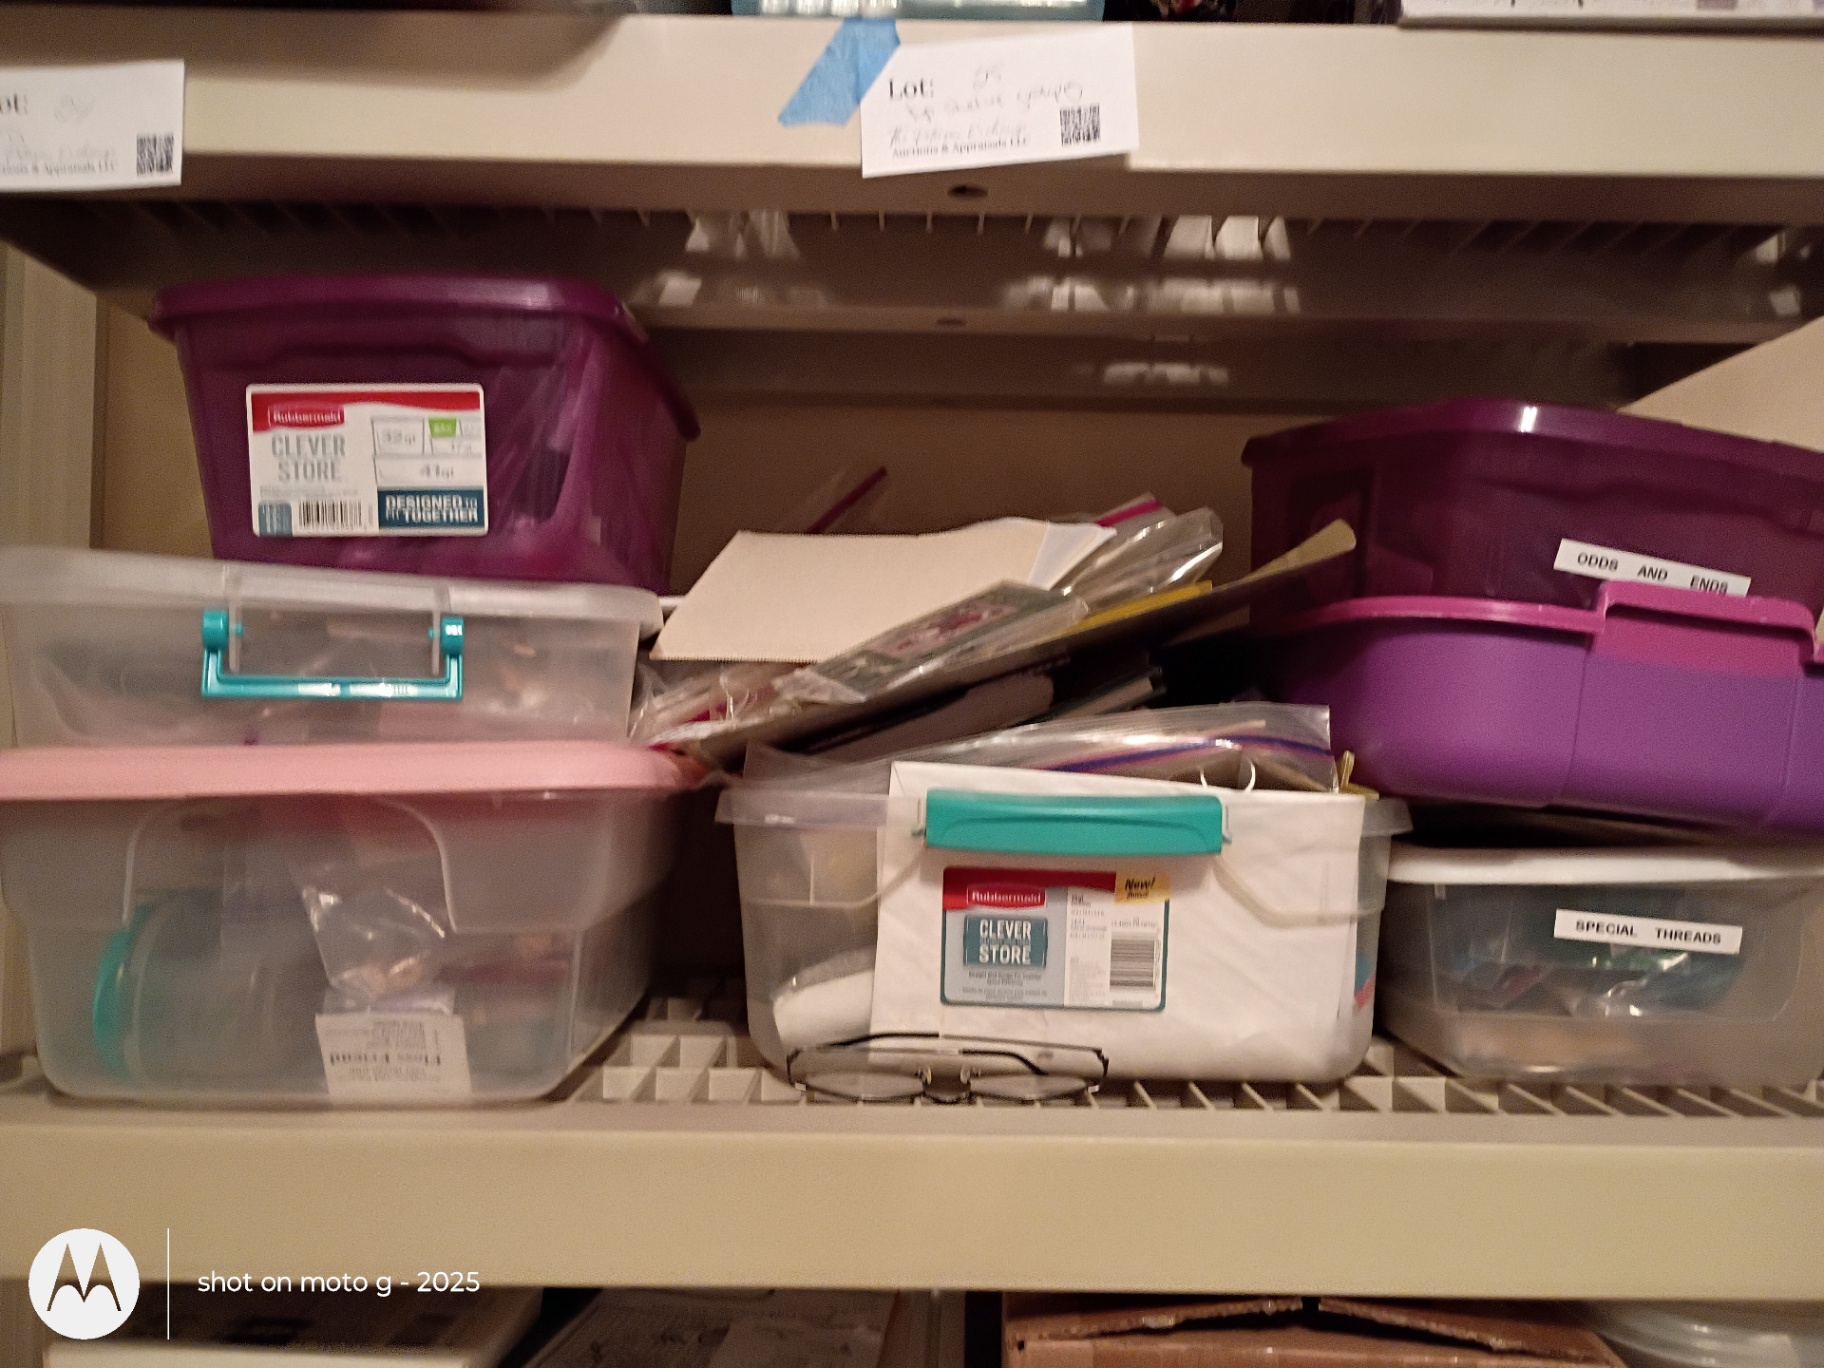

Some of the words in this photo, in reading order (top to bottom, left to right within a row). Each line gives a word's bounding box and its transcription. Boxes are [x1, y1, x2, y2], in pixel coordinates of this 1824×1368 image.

[889, 77, 933, 101] Lot:
[0, 92, 29, 116] ot:
[952, 138, 1007, 155] Appraisals
[272, 409, 341, 424] Rubbermaid
[271, 433, 346, 457] CLEVER
[278, 459, 342, 481] STORE
[385, 494, 463, 510] DESIGNED
[403, 508, 479, 523] TOGETHER
[1577, 551, 1619, 572] ODDS
[1637, 564, 1669, 582] AND
[1690, 574, 1728, 595] ENDS
[1124, 876, 1156, 892] New!
[971, 890, 1041, 904] Rubbermaid
[979, 919, 1032, 940] CLEVER
[1575, 918, 1638, 938] SPECIAL
[1655, 926, 1722, 945] THREADS
[978, 943, 1032, 965] STORE
